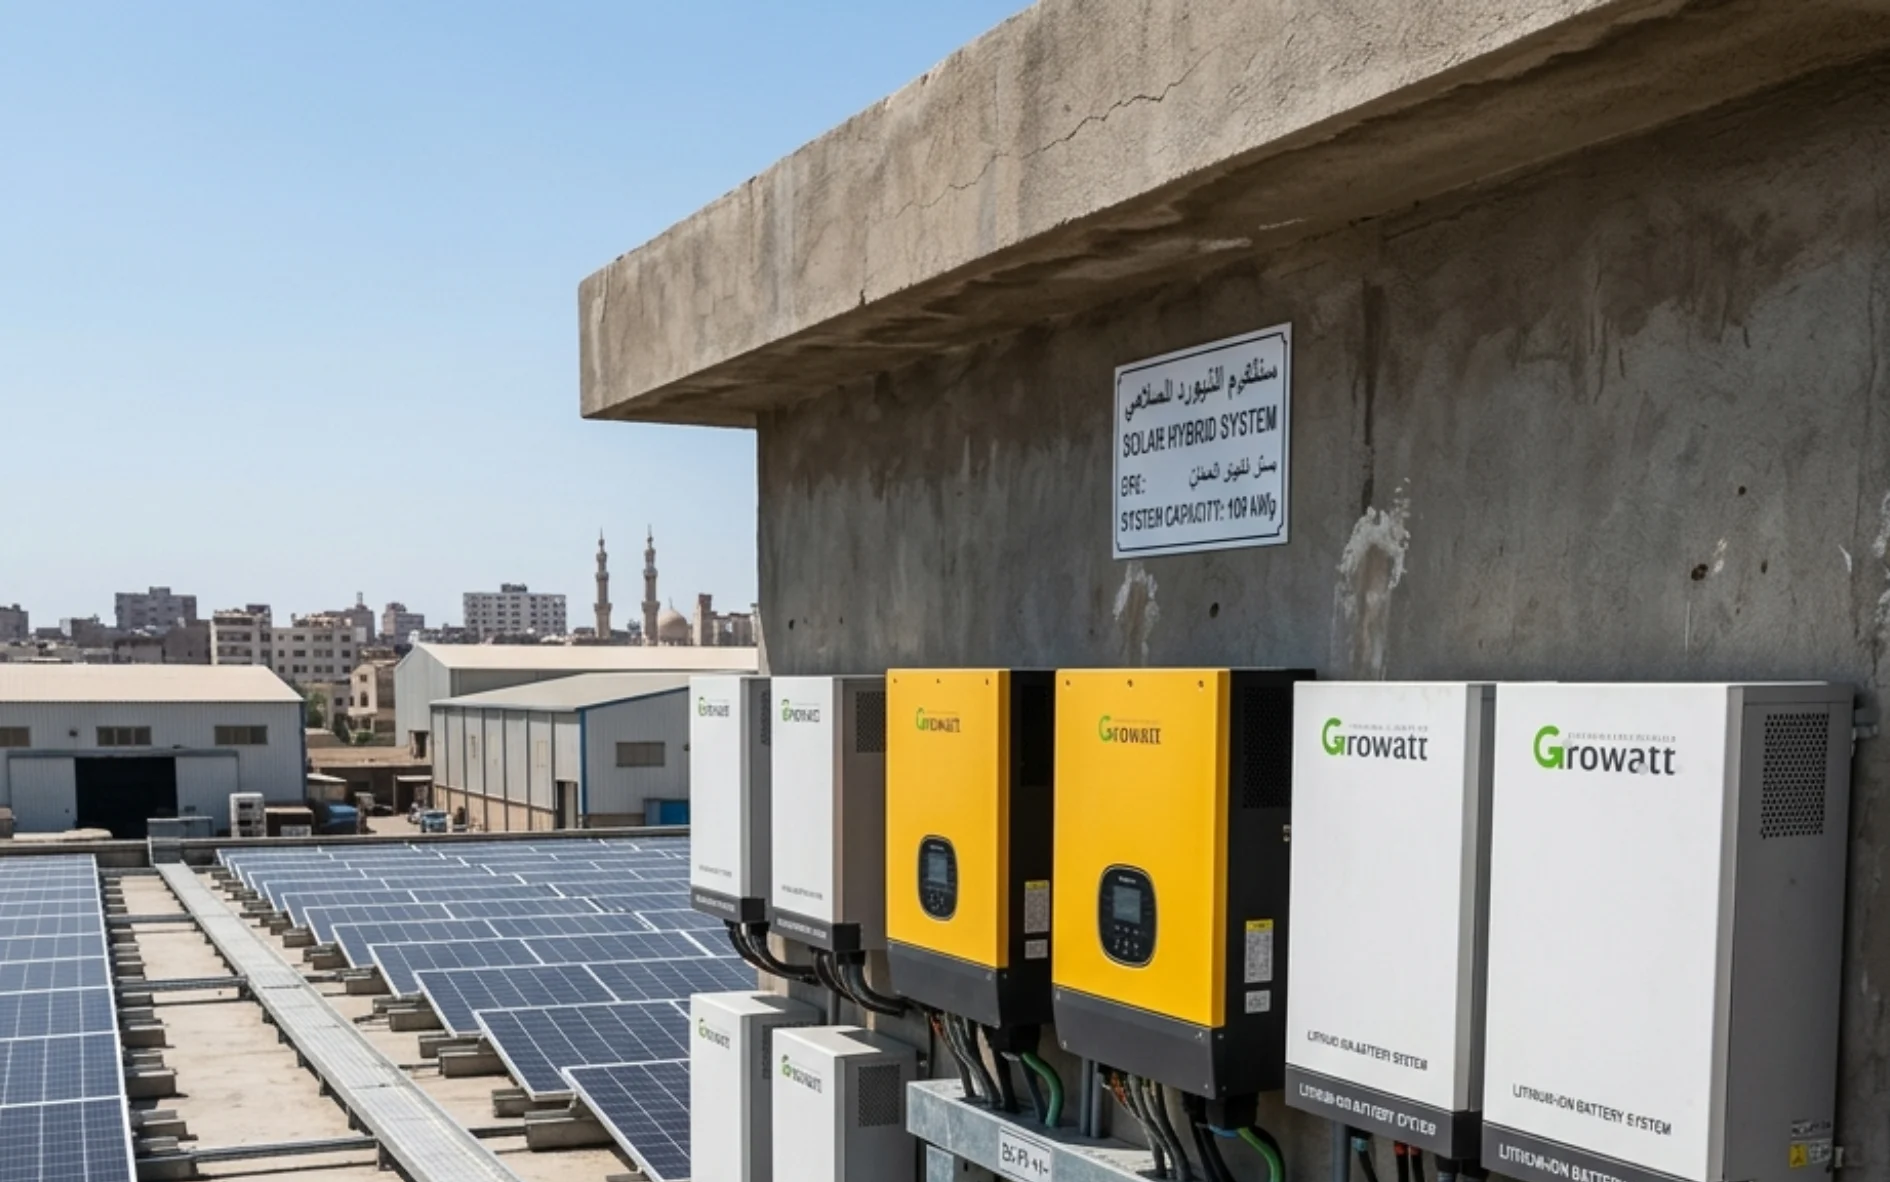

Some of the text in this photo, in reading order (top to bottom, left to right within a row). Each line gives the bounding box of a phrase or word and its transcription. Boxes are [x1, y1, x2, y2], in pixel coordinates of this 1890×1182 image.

[1220, 405, 1278, 439] SYSTEM
[1322, 717, 1428, 761] Growatt
[1532, 725, 1677, 776] Growatt
